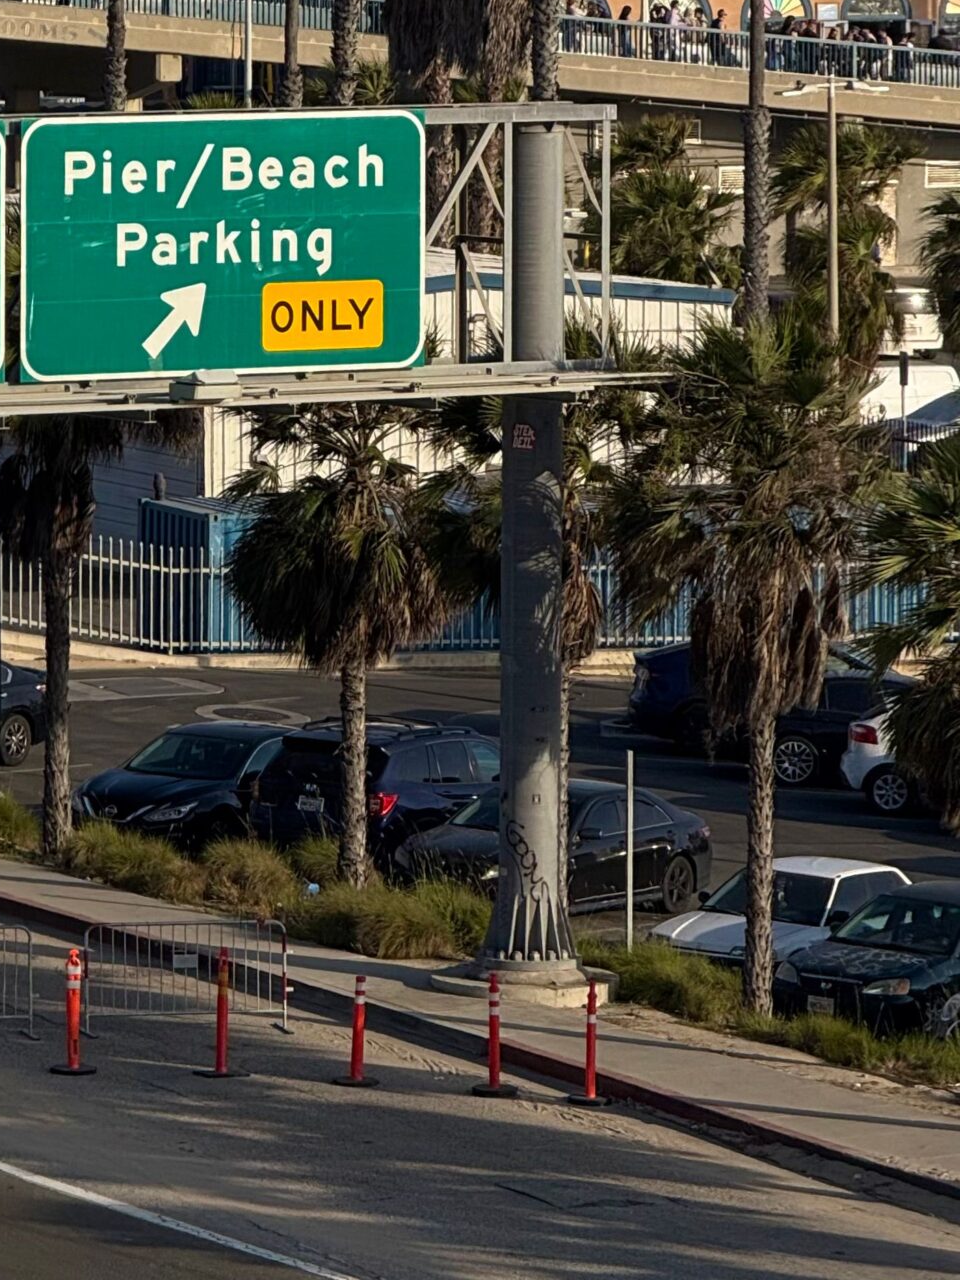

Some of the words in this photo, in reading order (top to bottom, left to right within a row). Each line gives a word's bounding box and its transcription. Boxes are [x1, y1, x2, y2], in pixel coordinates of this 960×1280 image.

[64, 143, 384, 209] Pier/Beach
[116, 219, 332, 276] Parking
[270, 297, 374, 333] ONLY
